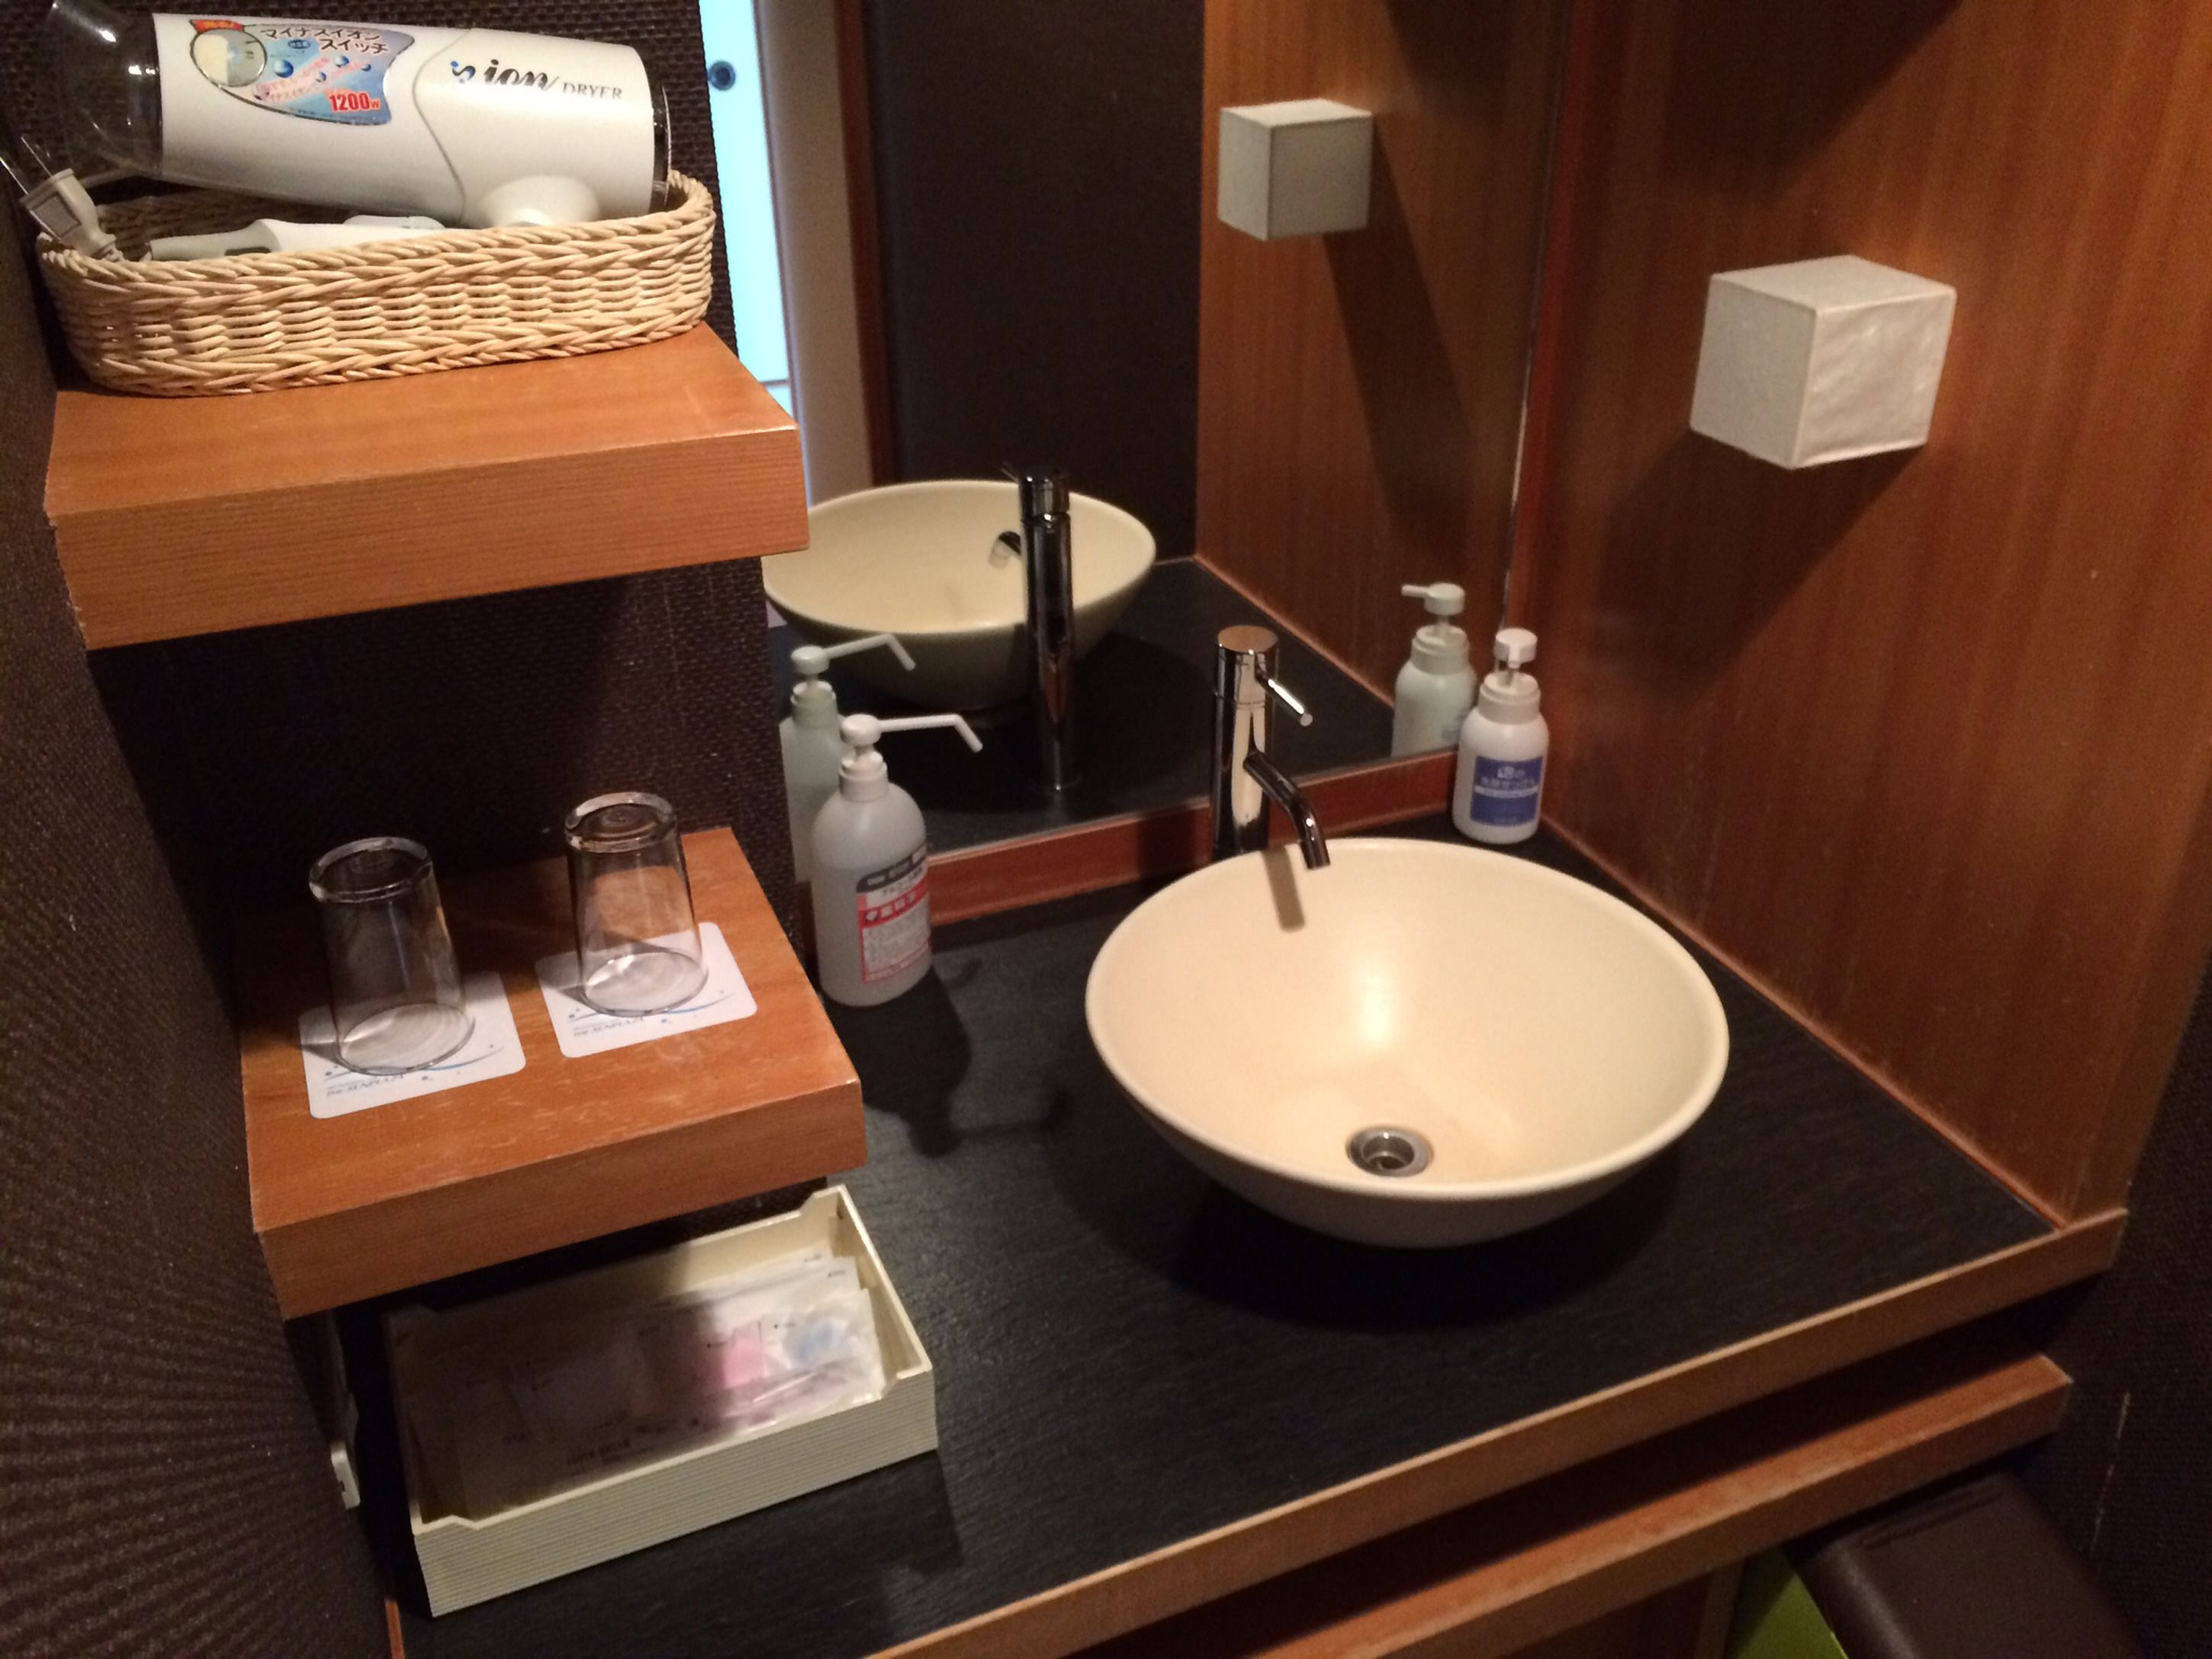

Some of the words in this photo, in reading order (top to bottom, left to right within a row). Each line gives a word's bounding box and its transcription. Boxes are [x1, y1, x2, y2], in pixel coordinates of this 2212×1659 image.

[260, 27, 381, 40] マイナスイオン
[319, 39, 389, 54] スイッチ
[562, 82, 623, 99] DRYER
